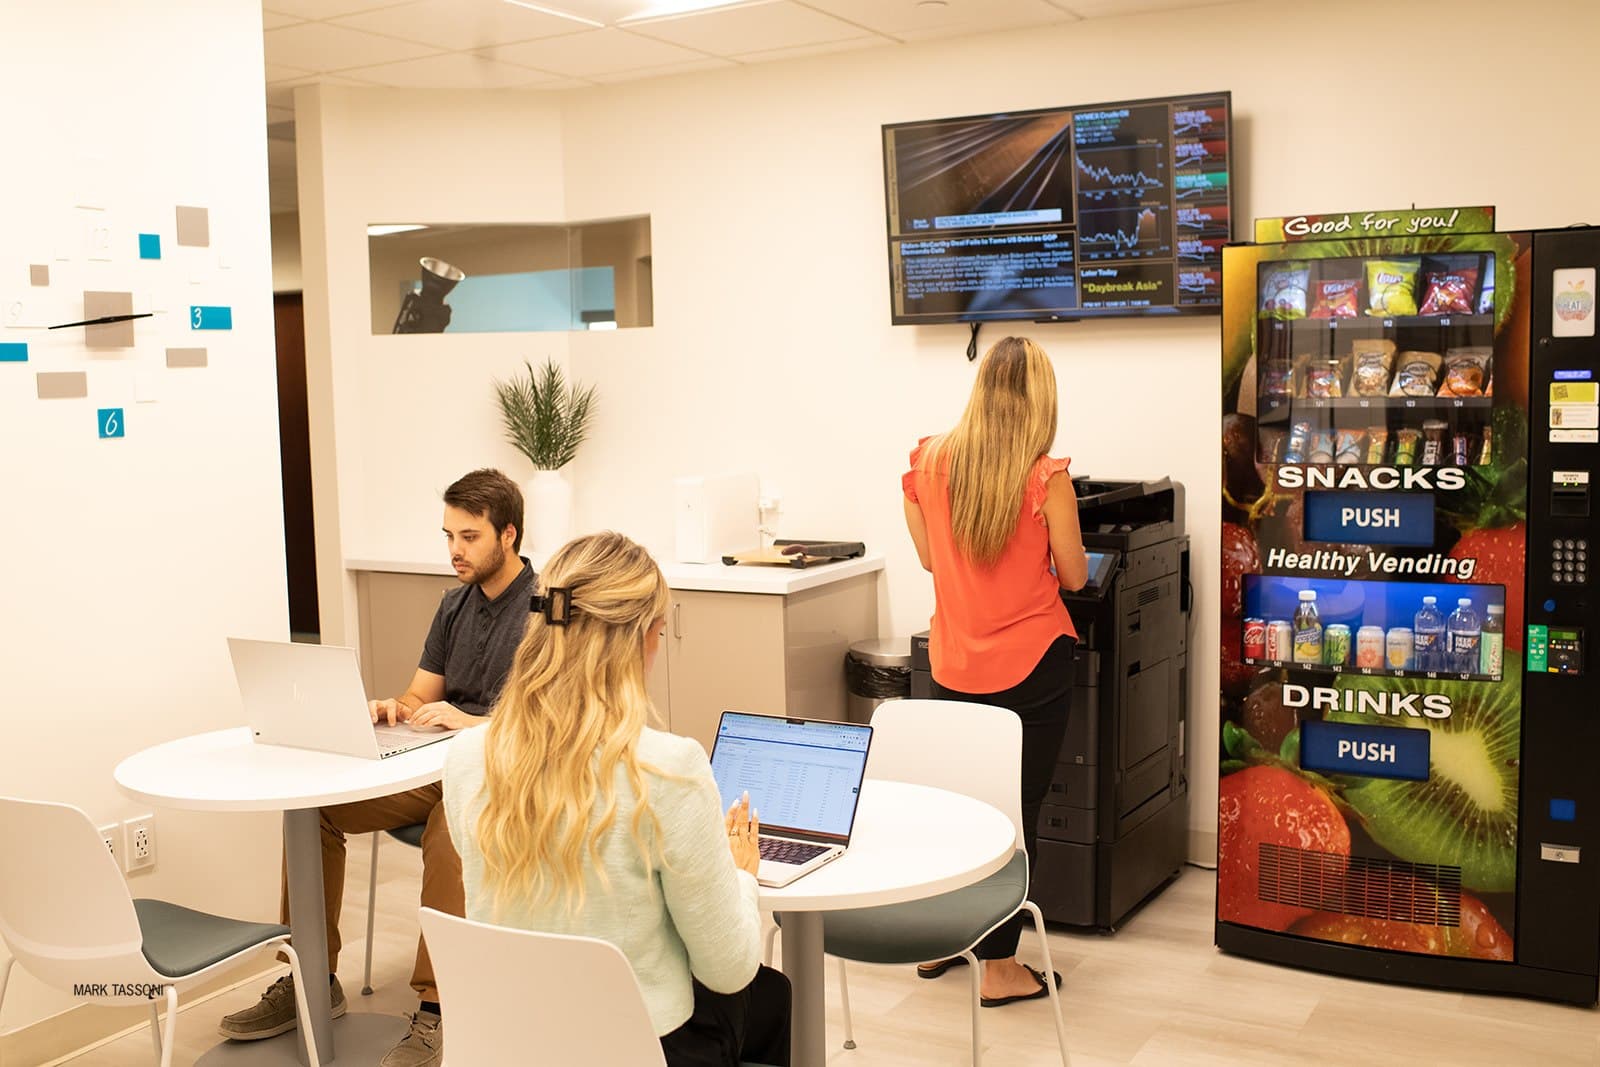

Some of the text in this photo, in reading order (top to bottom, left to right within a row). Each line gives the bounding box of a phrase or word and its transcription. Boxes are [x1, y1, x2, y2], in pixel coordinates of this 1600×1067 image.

[1284, 209, 1459, 236] Good for you!
[193, 307, 202, 328] 3
[105, 411, 118, 436] 6
[1278, 466, 1466, 490] SNACKS
[1342, 508, 1400, 528] PUSH
[1268, 548, 1476, 579] Healthy Vending
[1282, 684, 1452, 718] DRINKS
[1338, 740, 1396, 763] PUSH
